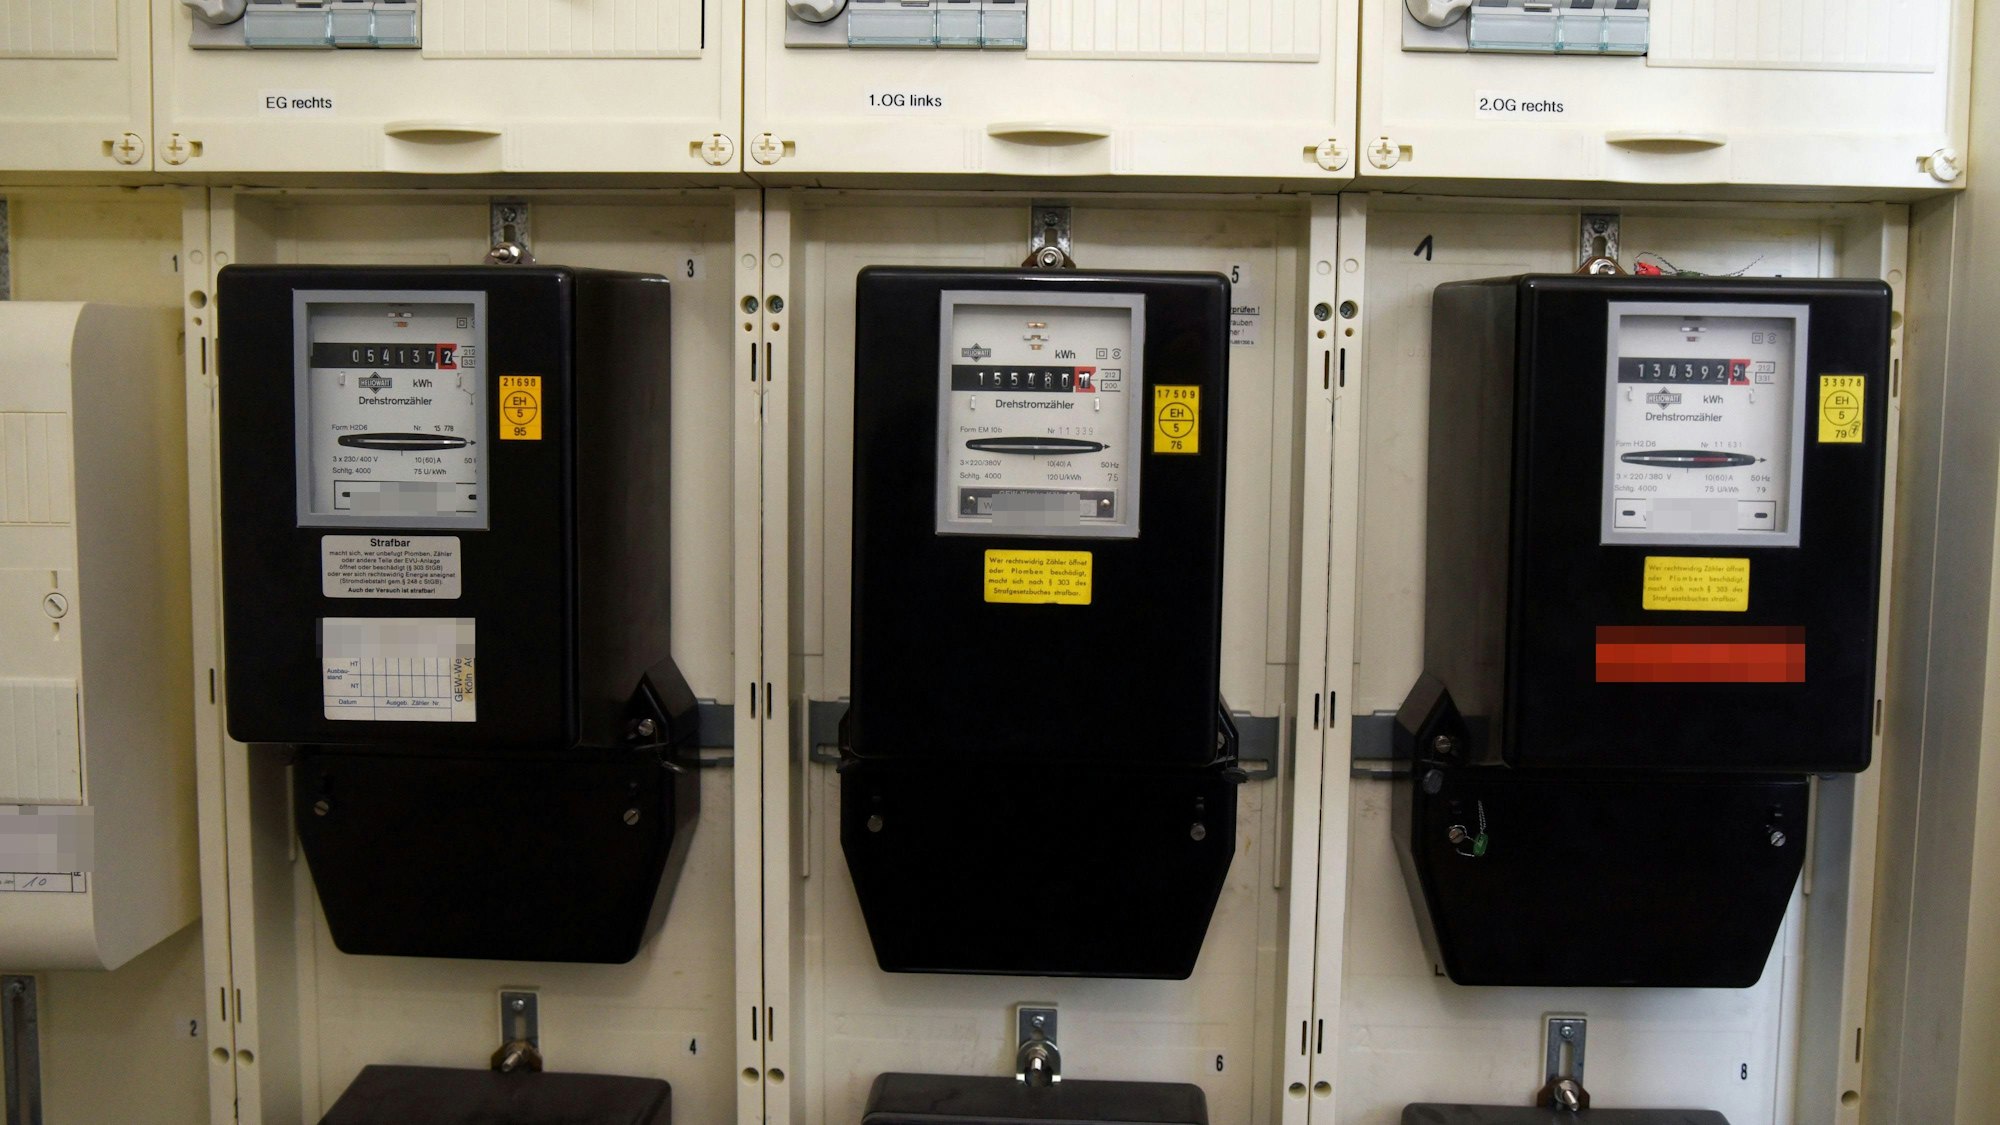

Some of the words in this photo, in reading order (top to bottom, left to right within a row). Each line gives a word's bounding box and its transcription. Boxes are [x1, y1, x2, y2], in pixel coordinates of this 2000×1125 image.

[266, 96, 287, 109] EG
[292, 96, 332, 109] rechts
[869, 93, 905, 107] 1.OG
[910, 94, 942, 107] links
[1479, 97, 1516, 112] 2.OG
[1521, 99, 1564, 113] rechts
[1413, 234, 1433, 261] 1
[172, 254, 178, 272] 1
[687, 259, 694, 278] 3
[1231, 265, 1240, 284] 5
[1054, 349, 1076, 359] kWh
[413, 379, 433, 388] kWh
[503, 378, 536, 387] 21698
[1823, 378, 1861, 387] 33978
[1157, 390, 1195, 398] 17509
[358, 396, 433, 405] Drehstromzähler
[512, 396, 527, 405] EH
[1703, 395, 1724, 404] kWh
[1835, 396, 1849, 405] EH
[995, 399, 1074, 410] Drehstromzähler
[516, 408, 524, 418] 5
[1170, 408, 1184, 417] EH
[1645, 412, 1723, 422] Drehstromzähler
[513, 427, 527, 436] 95
[1173, 423, 1180, 432] 5
[1835, 429, 1847, 438] 79
[1171, 440, 1182, 449] 76
[1107, 473, 1119, 481] 75
[370, 538, 411, 547] Strafbar
[1005, 558, 1044, 566] rechtswidrig
[993, 588, 1051, 596] Strafgesetzbuches
[465, 673, 473, 694] Köln
[190, 1019, 198, 1037] 2
[689, 1038, 697, 1055] 4
[1216, 1054, 1224, 1072] 6
[1740, 1062, 1748, 1080] 8
